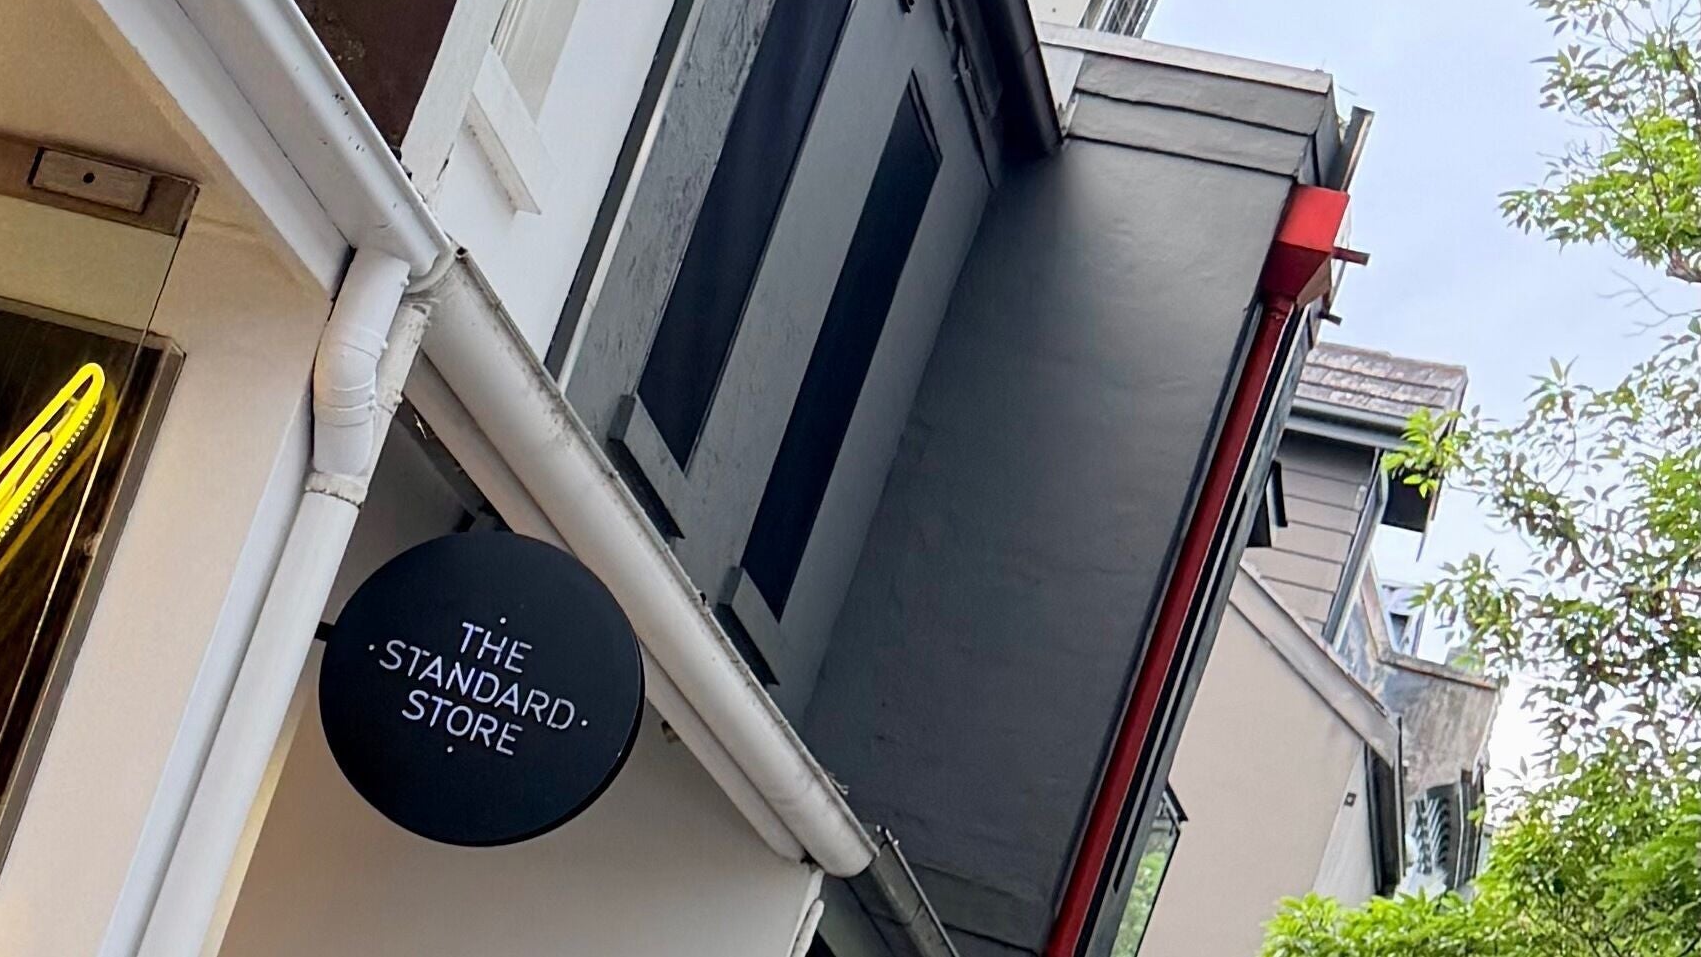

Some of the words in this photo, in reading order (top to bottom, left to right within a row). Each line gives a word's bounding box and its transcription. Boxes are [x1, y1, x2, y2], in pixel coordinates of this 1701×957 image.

[461, 621, 532, 673] THE
[379, 639, 575, 730] STANDARD
[401, 689, 523, 756] STORE
